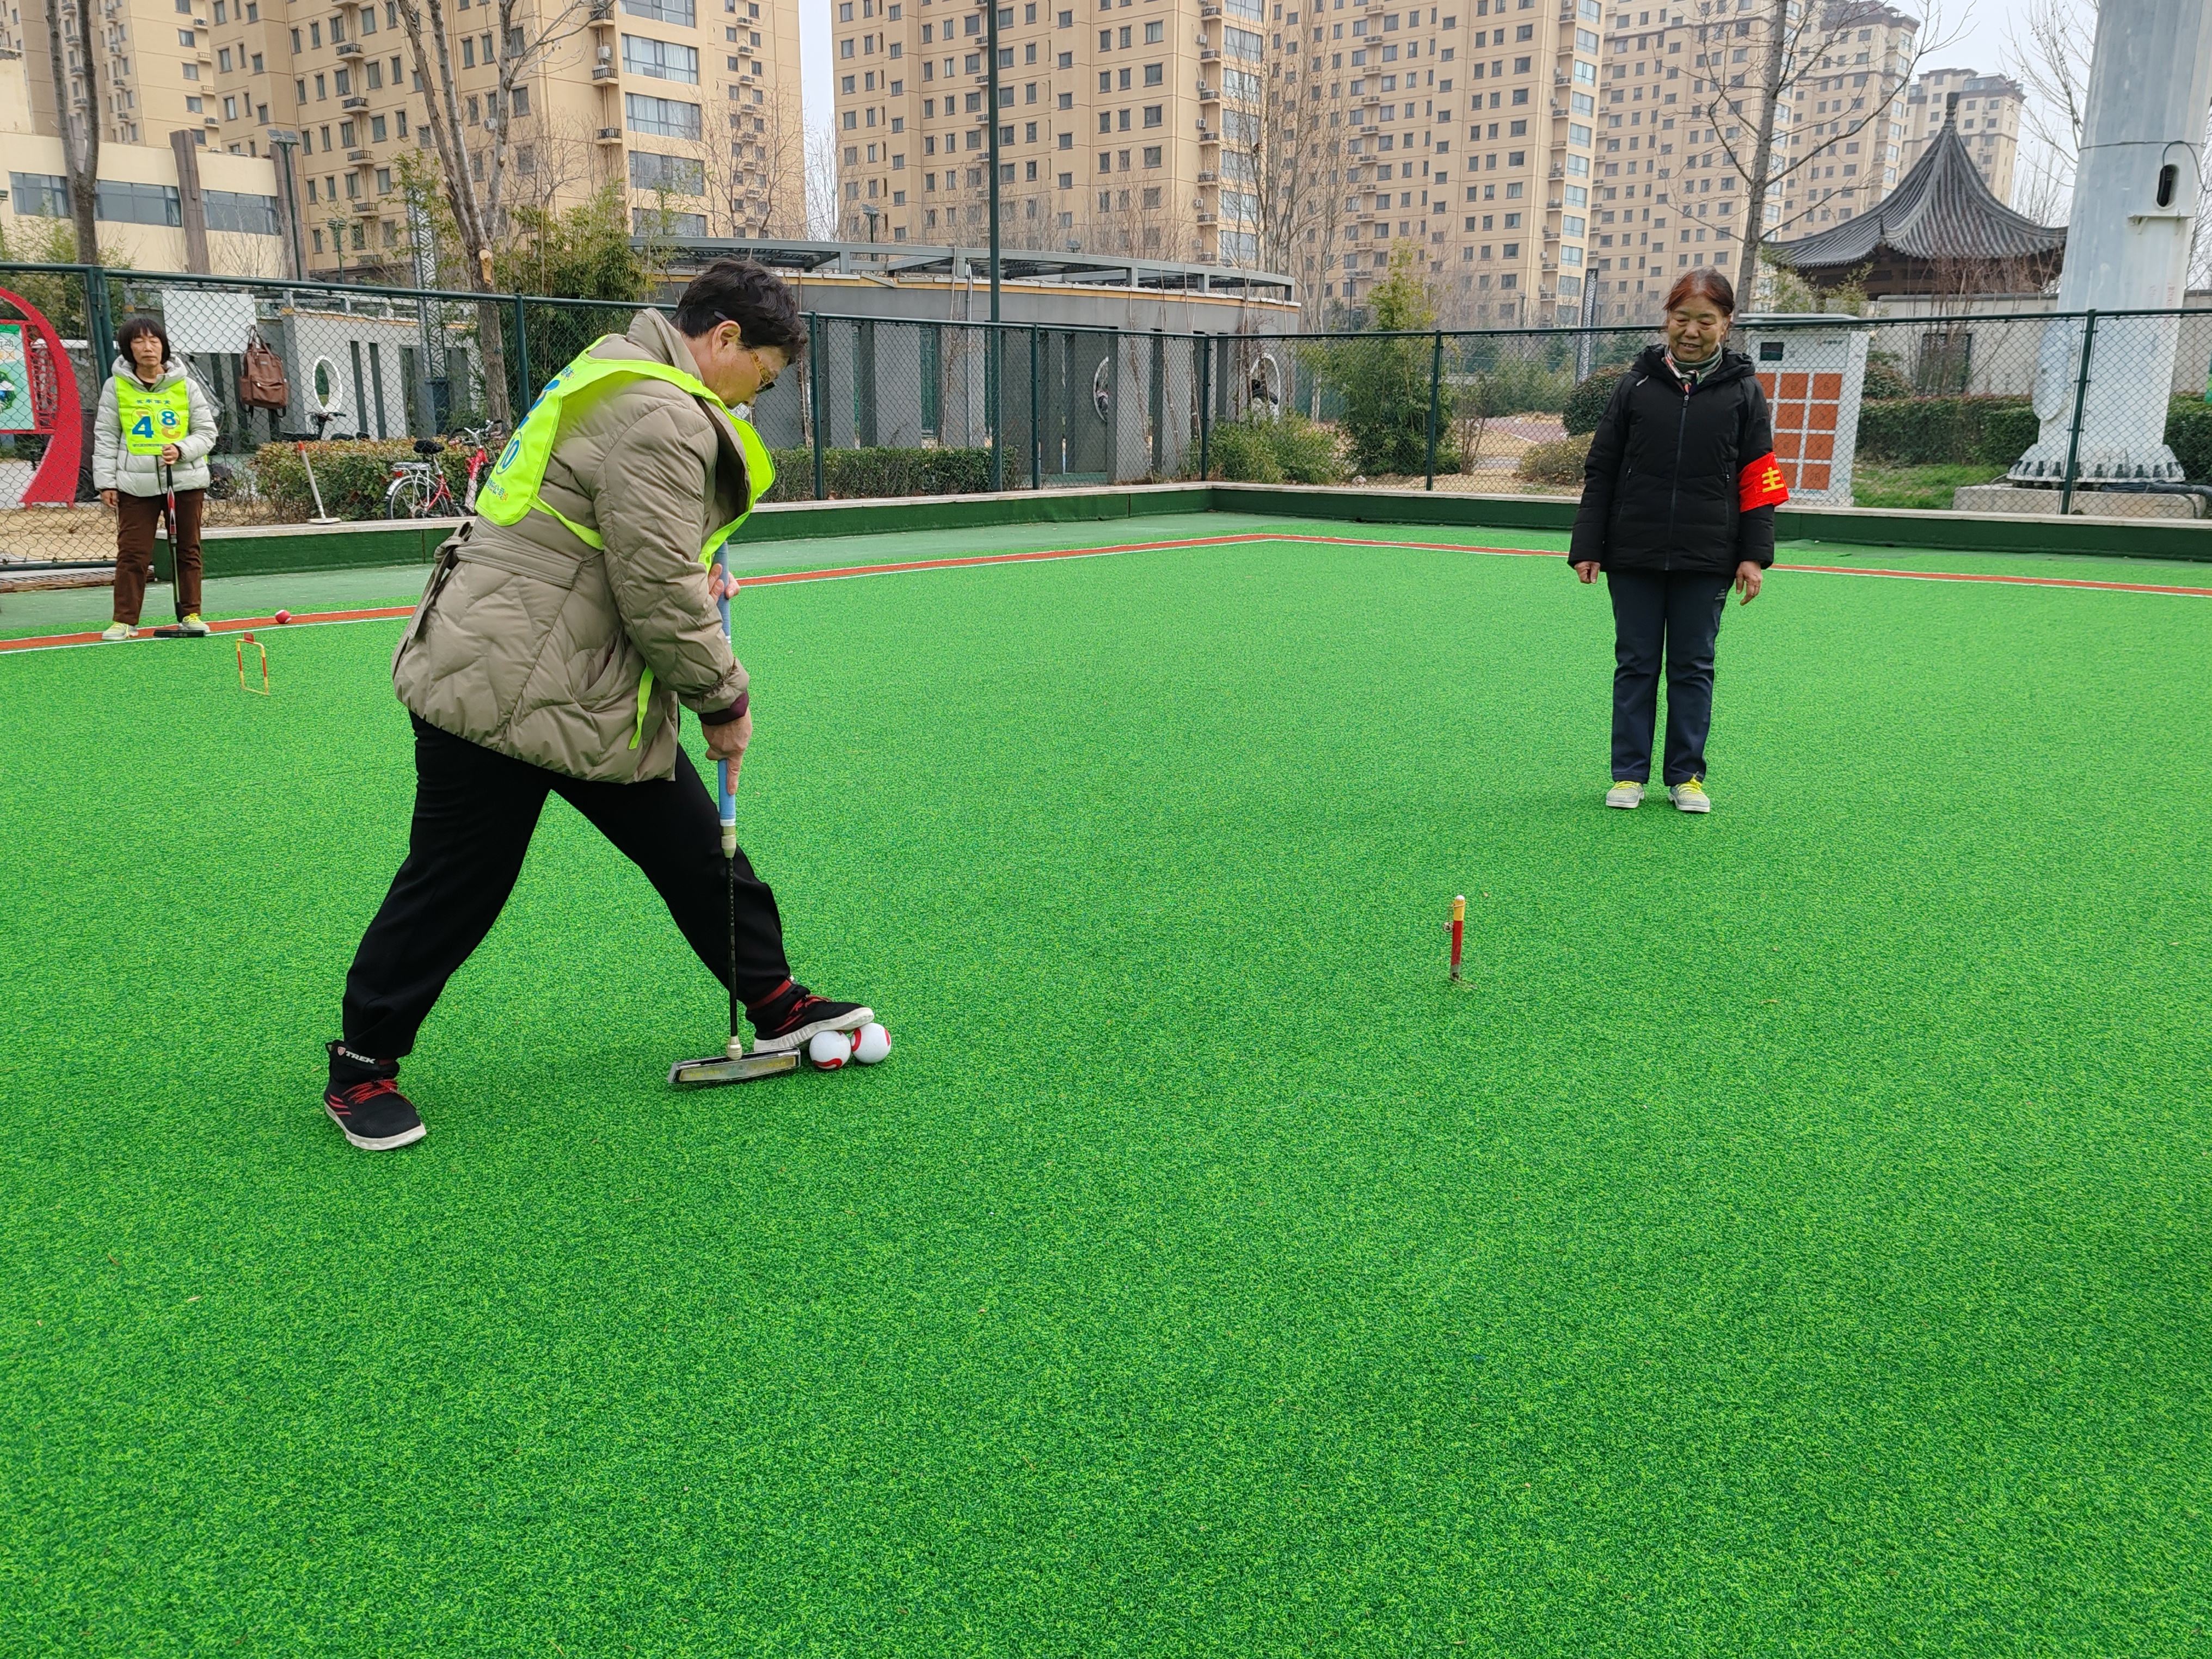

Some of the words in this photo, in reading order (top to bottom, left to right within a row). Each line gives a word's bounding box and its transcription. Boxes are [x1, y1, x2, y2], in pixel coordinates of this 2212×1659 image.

[132, 416, 155, 439] 4
[162, 411, 176, 426] 8
[500, 437, 520, 470] 10
[1762, 466, 1785, 493] 主
[346, 1050, 376, 1065] TREK
